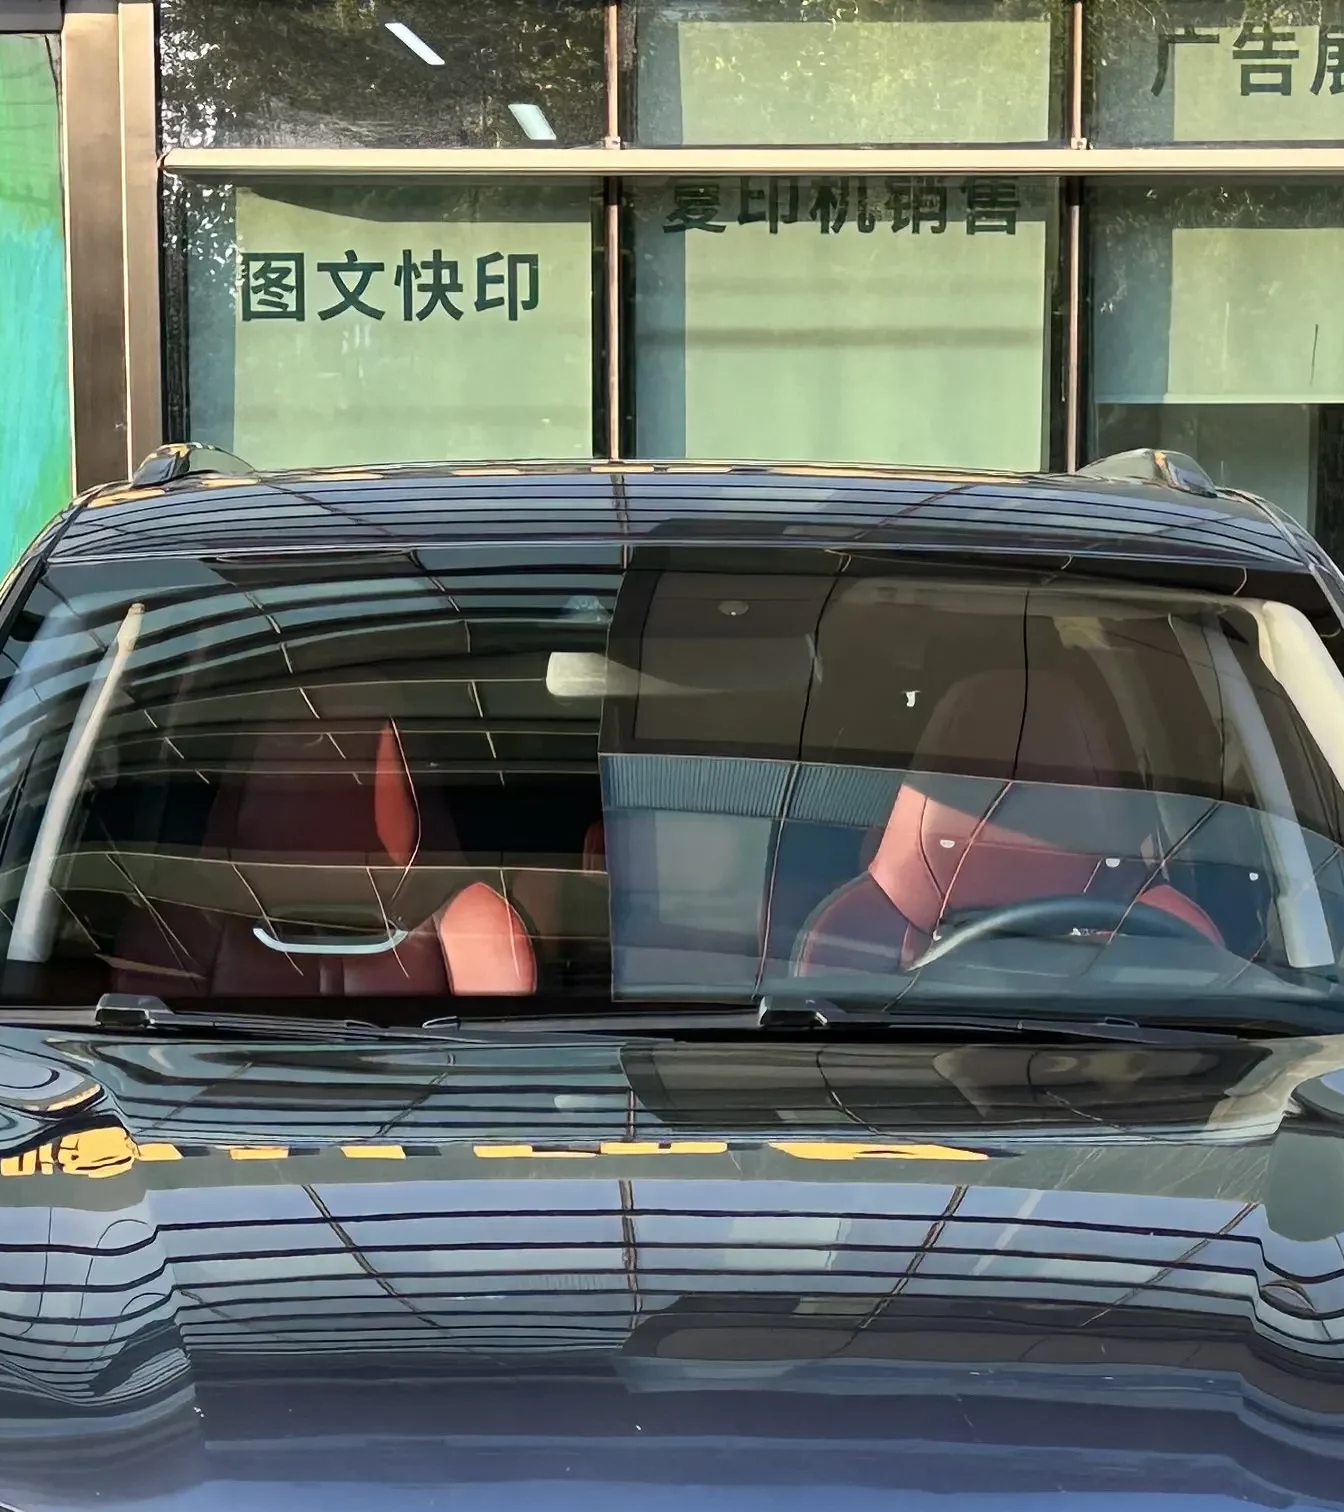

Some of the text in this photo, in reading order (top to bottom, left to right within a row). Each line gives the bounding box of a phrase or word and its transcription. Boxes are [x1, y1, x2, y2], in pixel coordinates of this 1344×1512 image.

[662, 175, 1021, 236] 复印机销售
[239, 248, 540, 323] 图文快印
